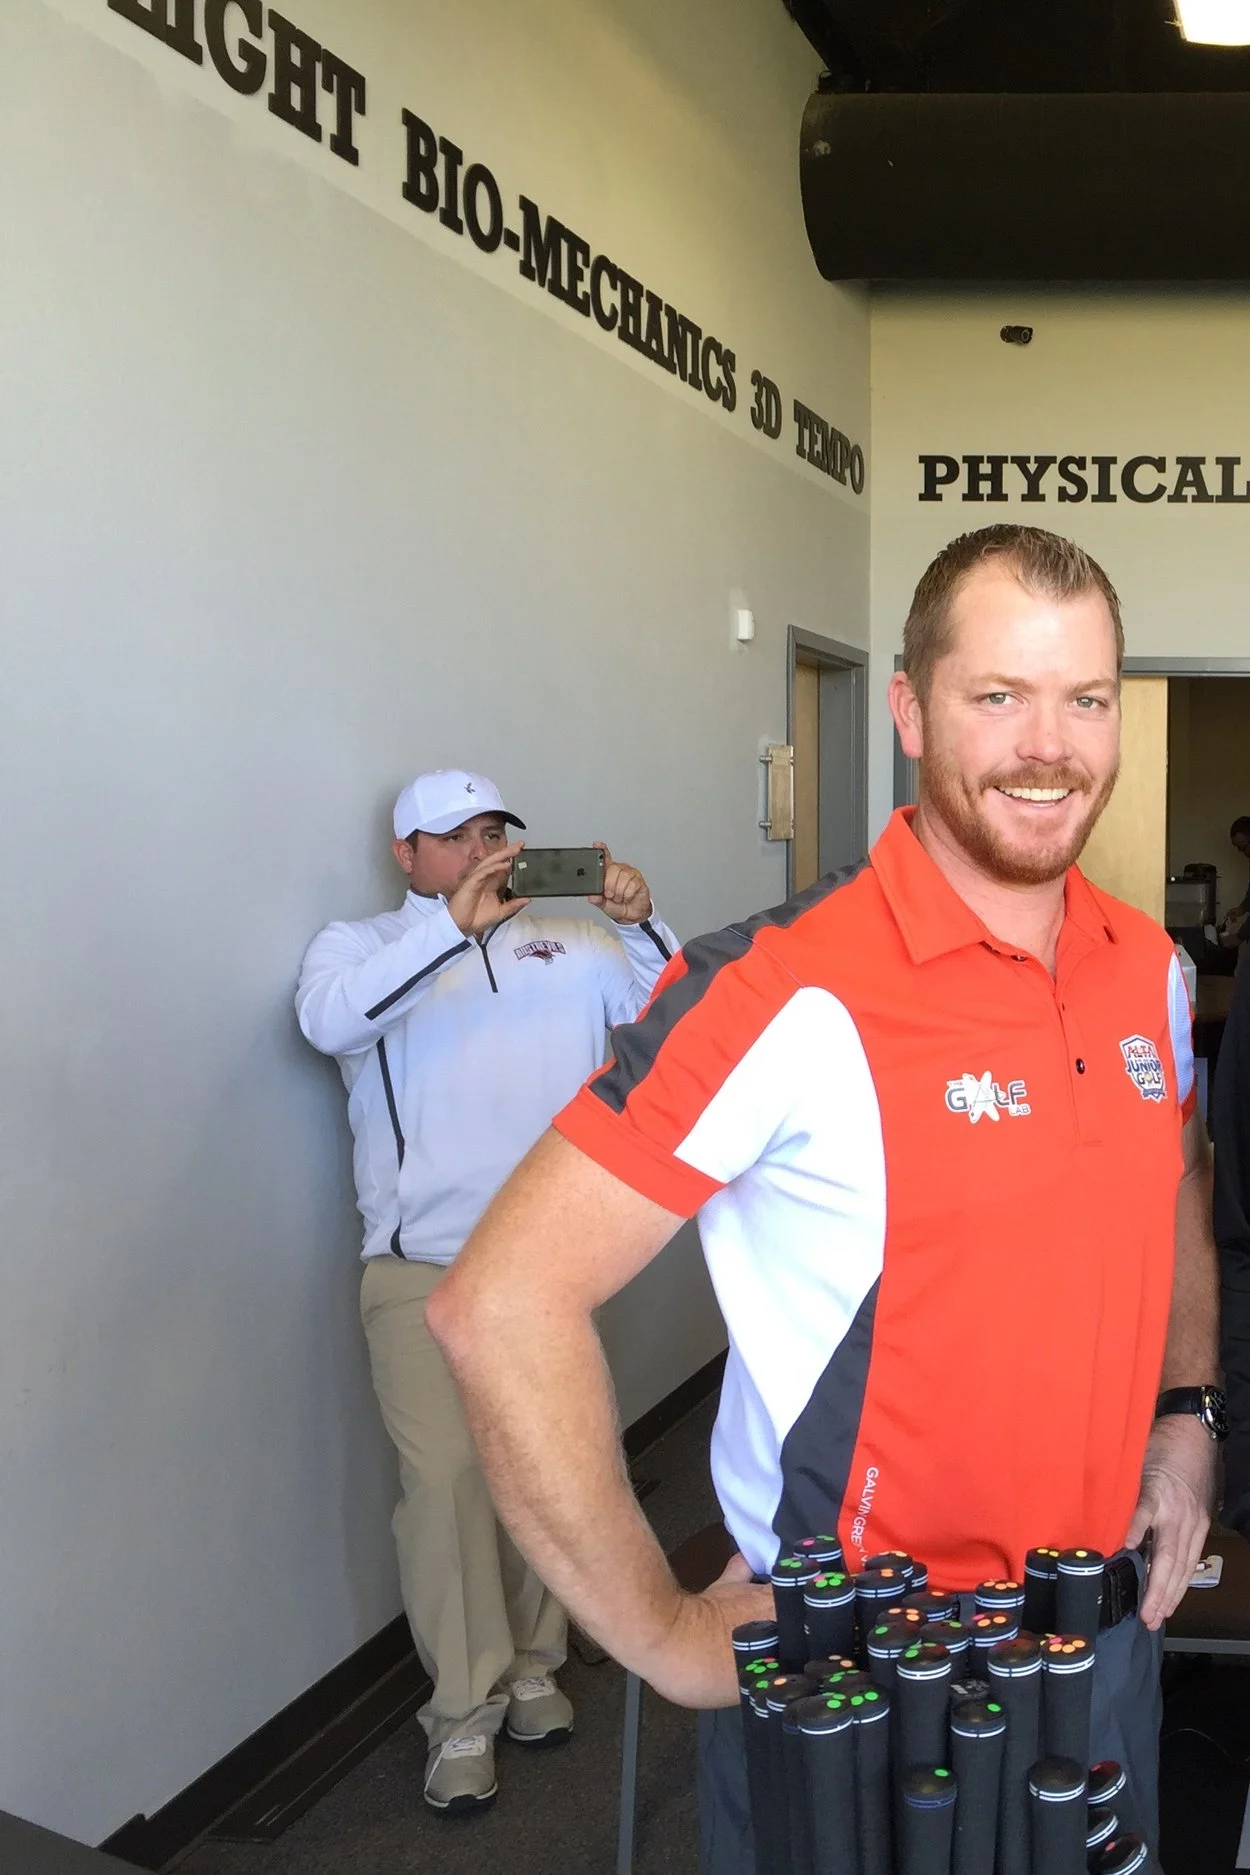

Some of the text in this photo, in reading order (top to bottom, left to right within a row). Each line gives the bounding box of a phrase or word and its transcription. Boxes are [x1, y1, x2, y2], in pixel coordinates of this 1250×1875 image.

[402, 108, 736, 412] BIO-MECHANICS
[751, 370, 782, 441] 3D
[794, 399, 865, 495] TEMPO
